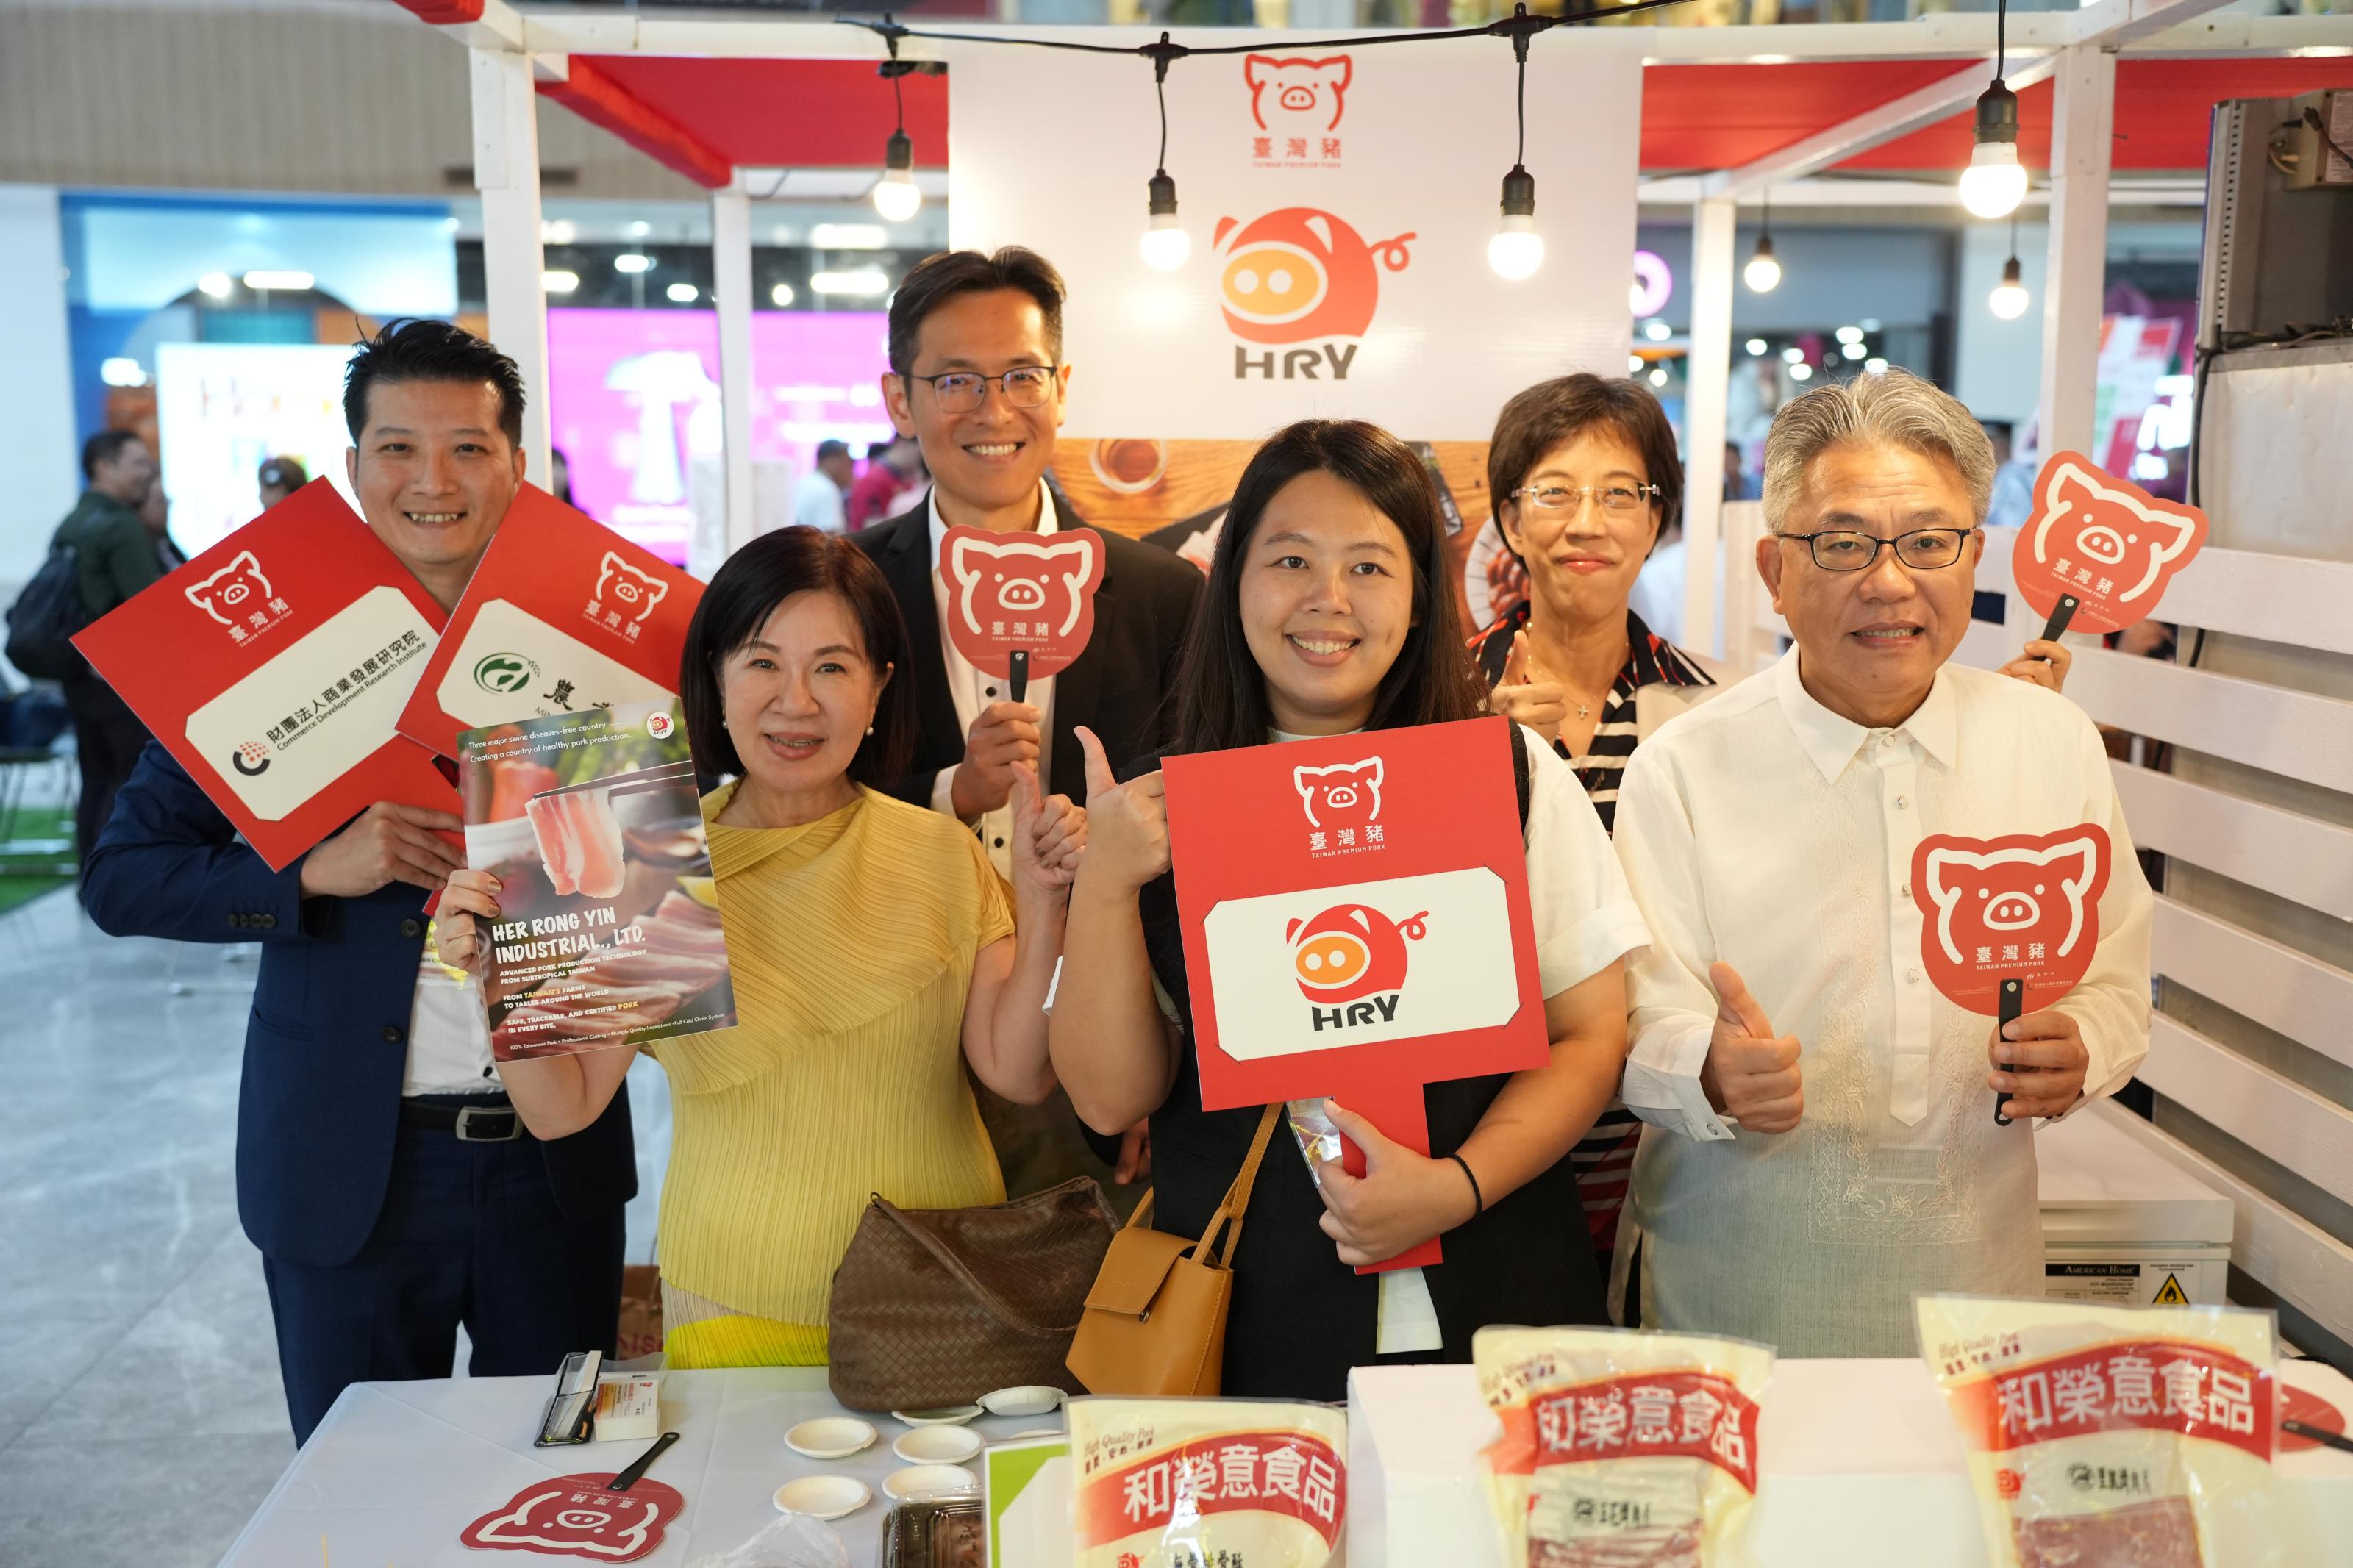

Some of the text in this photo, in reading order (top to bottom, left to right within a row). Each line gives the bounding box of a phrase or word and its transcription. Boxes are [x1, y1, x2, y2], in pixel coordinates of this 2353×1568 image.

[1252, 137, 1342, 159] 臺灣豬
[1235, 343, 1358, 380] HRY
[2052, 556, 2115, 595] 臺灣豬
[227, 596, 289, 643] 臺灣豬
[585, 598, 642, 640] 臺灣豬
[992, 620, 1049, 636] 臺灣豬
[266, 629, 421, 744] 財團法人商業發展研究院
[276, 640, 427, 751] Commerce Development Research Institute
[469, 723, 607, 750] Three major swine diseases-free country
[470, 753, 499, 763] Creating
[506, 747, 532, 757] country
[533, 744, 541, 753] of
[542, 740, 570, 752] healthy
[571, 737, 588, 749] pork
[589, 732, 632, 746] production.
[1309, 824, 1385, 851] 臺灣豬
[1311, 844, 1385, 859] TAIWAN PREMIUM PORK
[492, 906, 616, 942] HER RONG YIN
[495, 926, 646, 964] INDUSTRIAL., LTD.
[1976, 942, 2046, 964] 臺灣豬
[499, 948, 648, 978] ADVANCED PORK PRODUCTION TECHNOLOGY
[501, 965, 596, 985] FROM SUBTROPICAL TAIWAN
[2000, 962, 2028, 970] PREMIUM
[503, 994, 523, 1002] FROM
[562, 984, 586, 993] FARMS
[515, 1000, 540, 1009] TABLES
[540, 996, 570, 1005] AROUND
[585, 989, 610, 998] WORLD
[507, 1000, 639, 1026] SAFE, TRACEABLE, AND CERTIFIED PORK
[517, 1024, 540, 1033] EVERY
[540, 1022, 557, 1030] BITE.
[1311, 994, 1400, 1032] HRY
[523, 1041, 546, 1049] Taiwanese
[561, 1035, 589, 1044] Professional
[589, 1033, 607, 1041] Cutting
[629, 1025, 646, 1034] Quality
[646, 1022, 672, 1031] Inspections
[708, 1013, 725, 1021] System
[2064, 1265, 2107, 1275] AMERICAN
[1997, 1356, 2255, 1437] 和榮意食品
[1537, 1384, 1749, 1471] 和榮意食品
[1123, 1442, 1338, 1524] 和榮意食品
[568, 1493, 637, 1509] 臺灣豬
